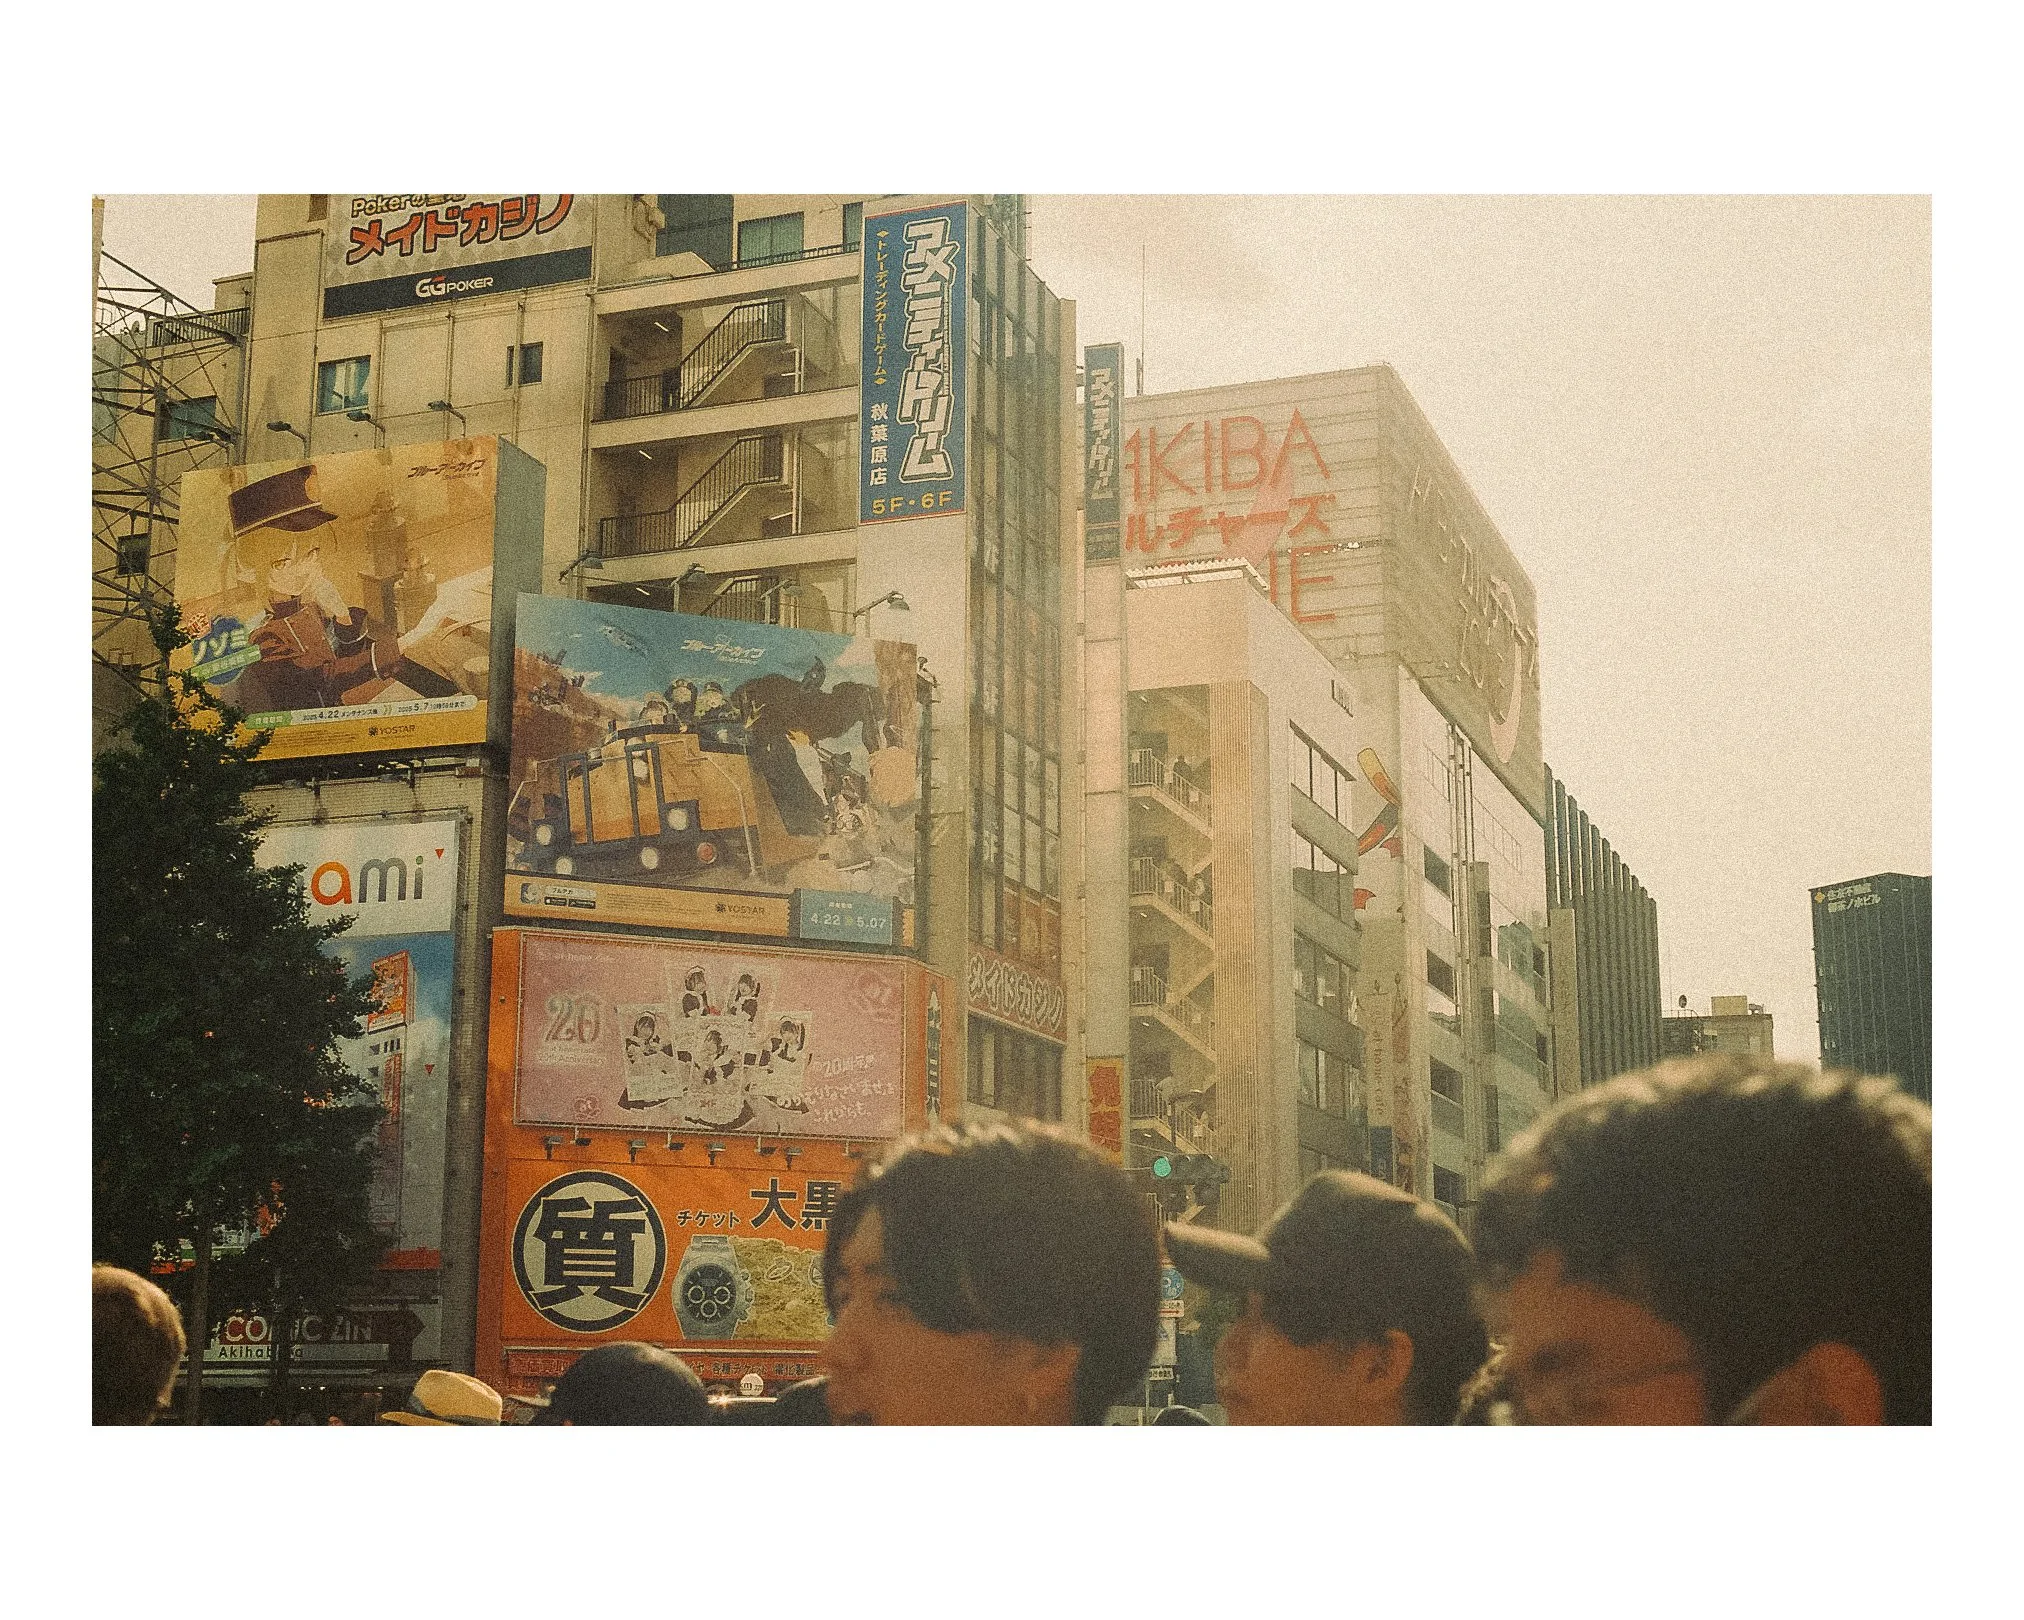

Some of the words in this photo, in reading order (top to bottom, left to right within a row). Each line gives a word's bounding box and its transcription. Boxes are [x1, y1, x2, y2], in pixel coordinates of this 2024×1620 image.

[346, 194, 574, 265] メイドカジノ
[415, 276, 493, 298] GGPOKER
[874, 240, 889, 375] トレーディングカードゲーム
[869, 403, 889, 486] 秋葉原店
[318, 710, 339, 719] 4.22
[378, 724, 416, 736] YOSTAR
[311, 855, 424, 905] ami
[727, 903, 765, 915] YOSTAR
[856, 915, 887, 929] 5.07
[676, 1210, 740, 1229] チケット
[750, 1177, 843, 1231] 大黒
[529, 1197, 649, 1310] 質
